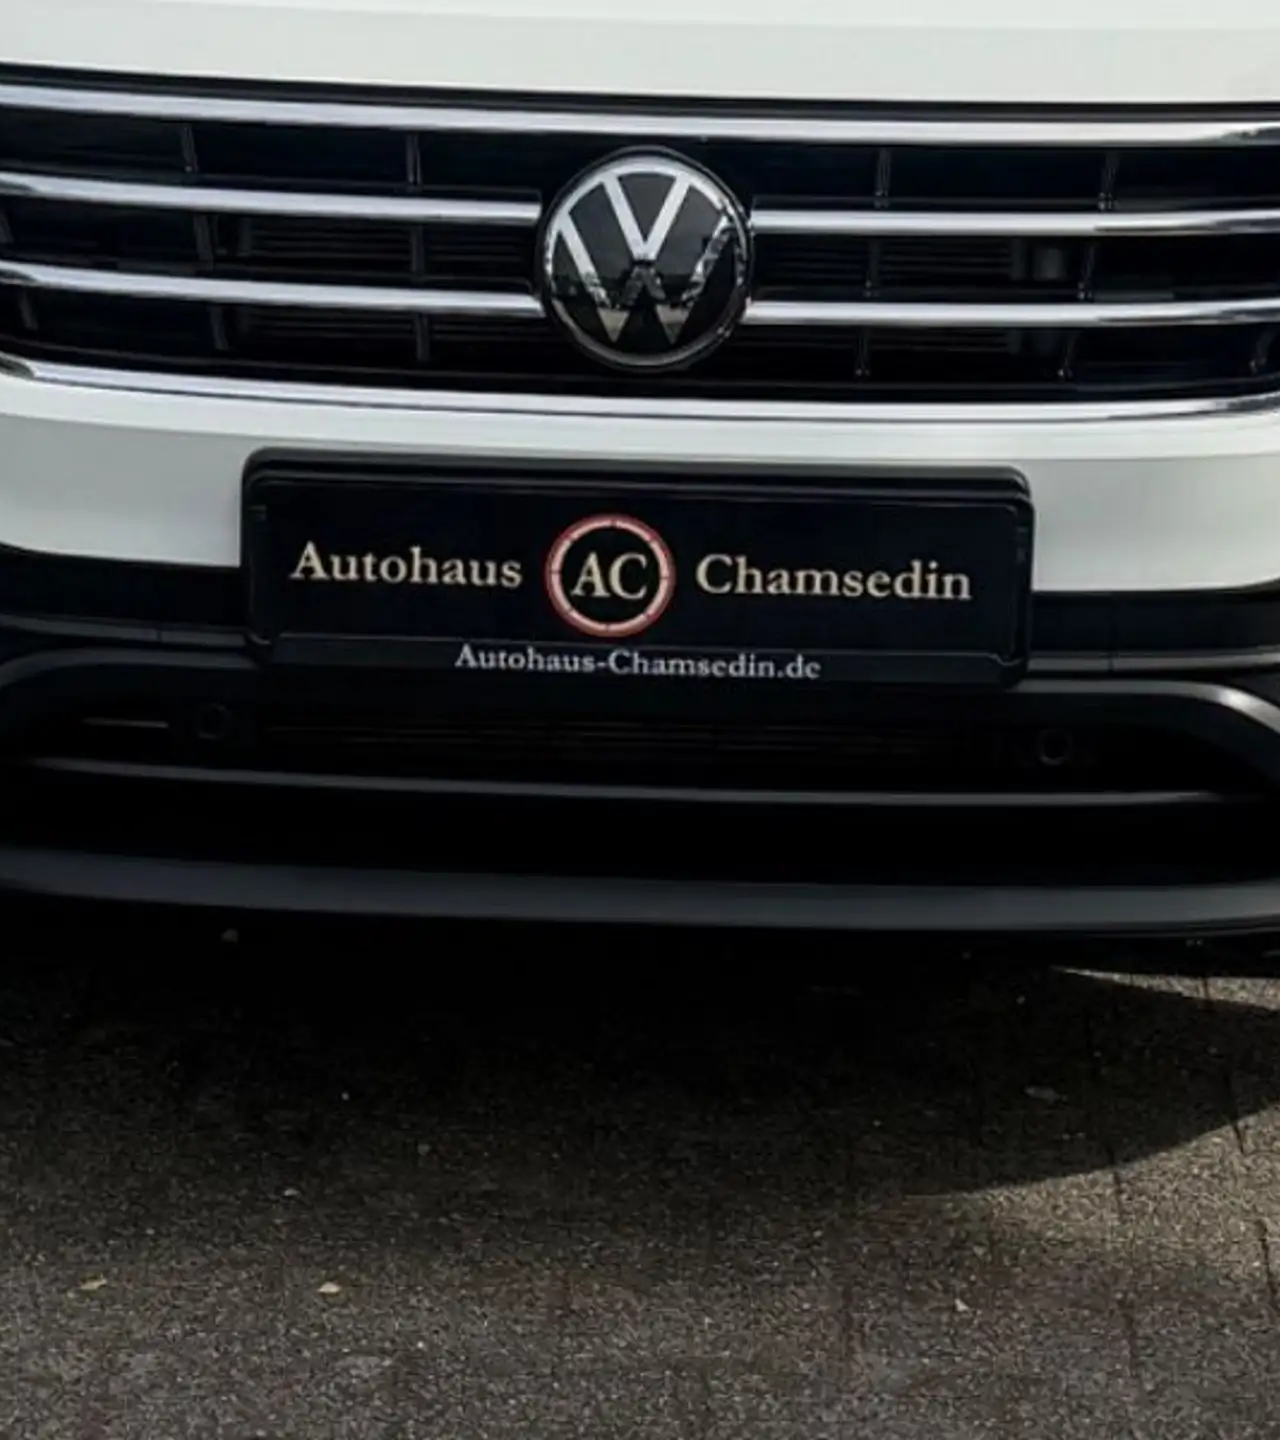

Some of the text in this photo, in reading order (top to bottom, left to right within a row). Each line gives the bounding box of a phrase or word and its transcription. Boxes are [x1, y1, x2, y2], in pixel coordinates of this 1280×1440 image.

[289, 540, 973, 601] Autohaus AC Chamsedin
[454, 642, 823, 681] Autohaus-Chamsedin.de
